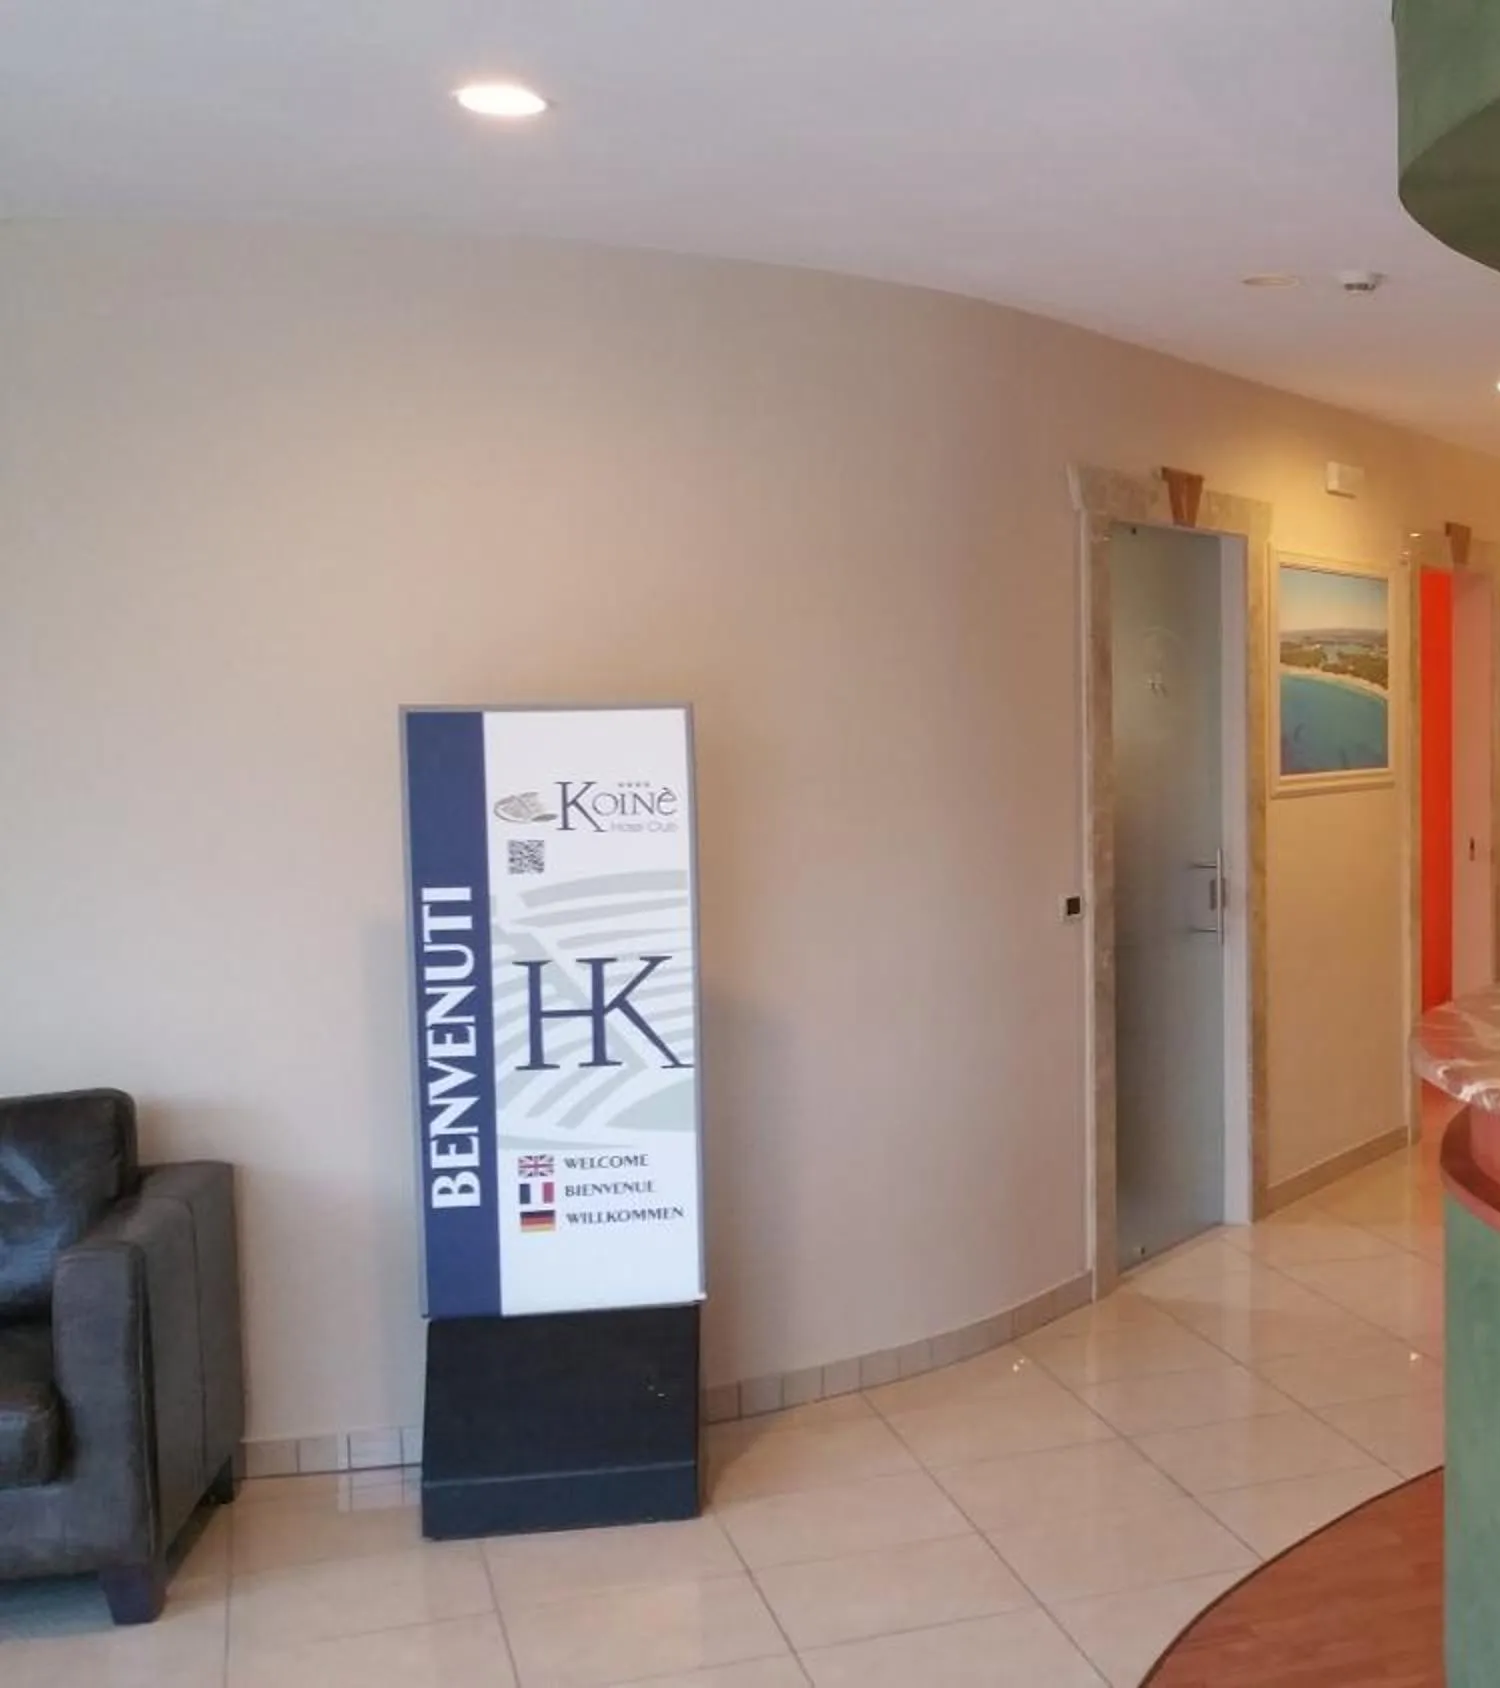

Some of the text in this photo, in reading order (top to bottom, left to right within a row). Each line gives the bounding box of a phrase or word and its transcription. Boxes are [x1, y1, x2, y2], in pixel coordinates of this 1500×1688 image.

[512, 955, 694, 1070] HK
[421, 886, 481, 1209] BENVENUTI
[563, 1153, 649, 1170] WELCOME
[564, 1180, 657, 1197] BIENVENUE
[565, 1206, 684, 1224] WILLKOMMEN
